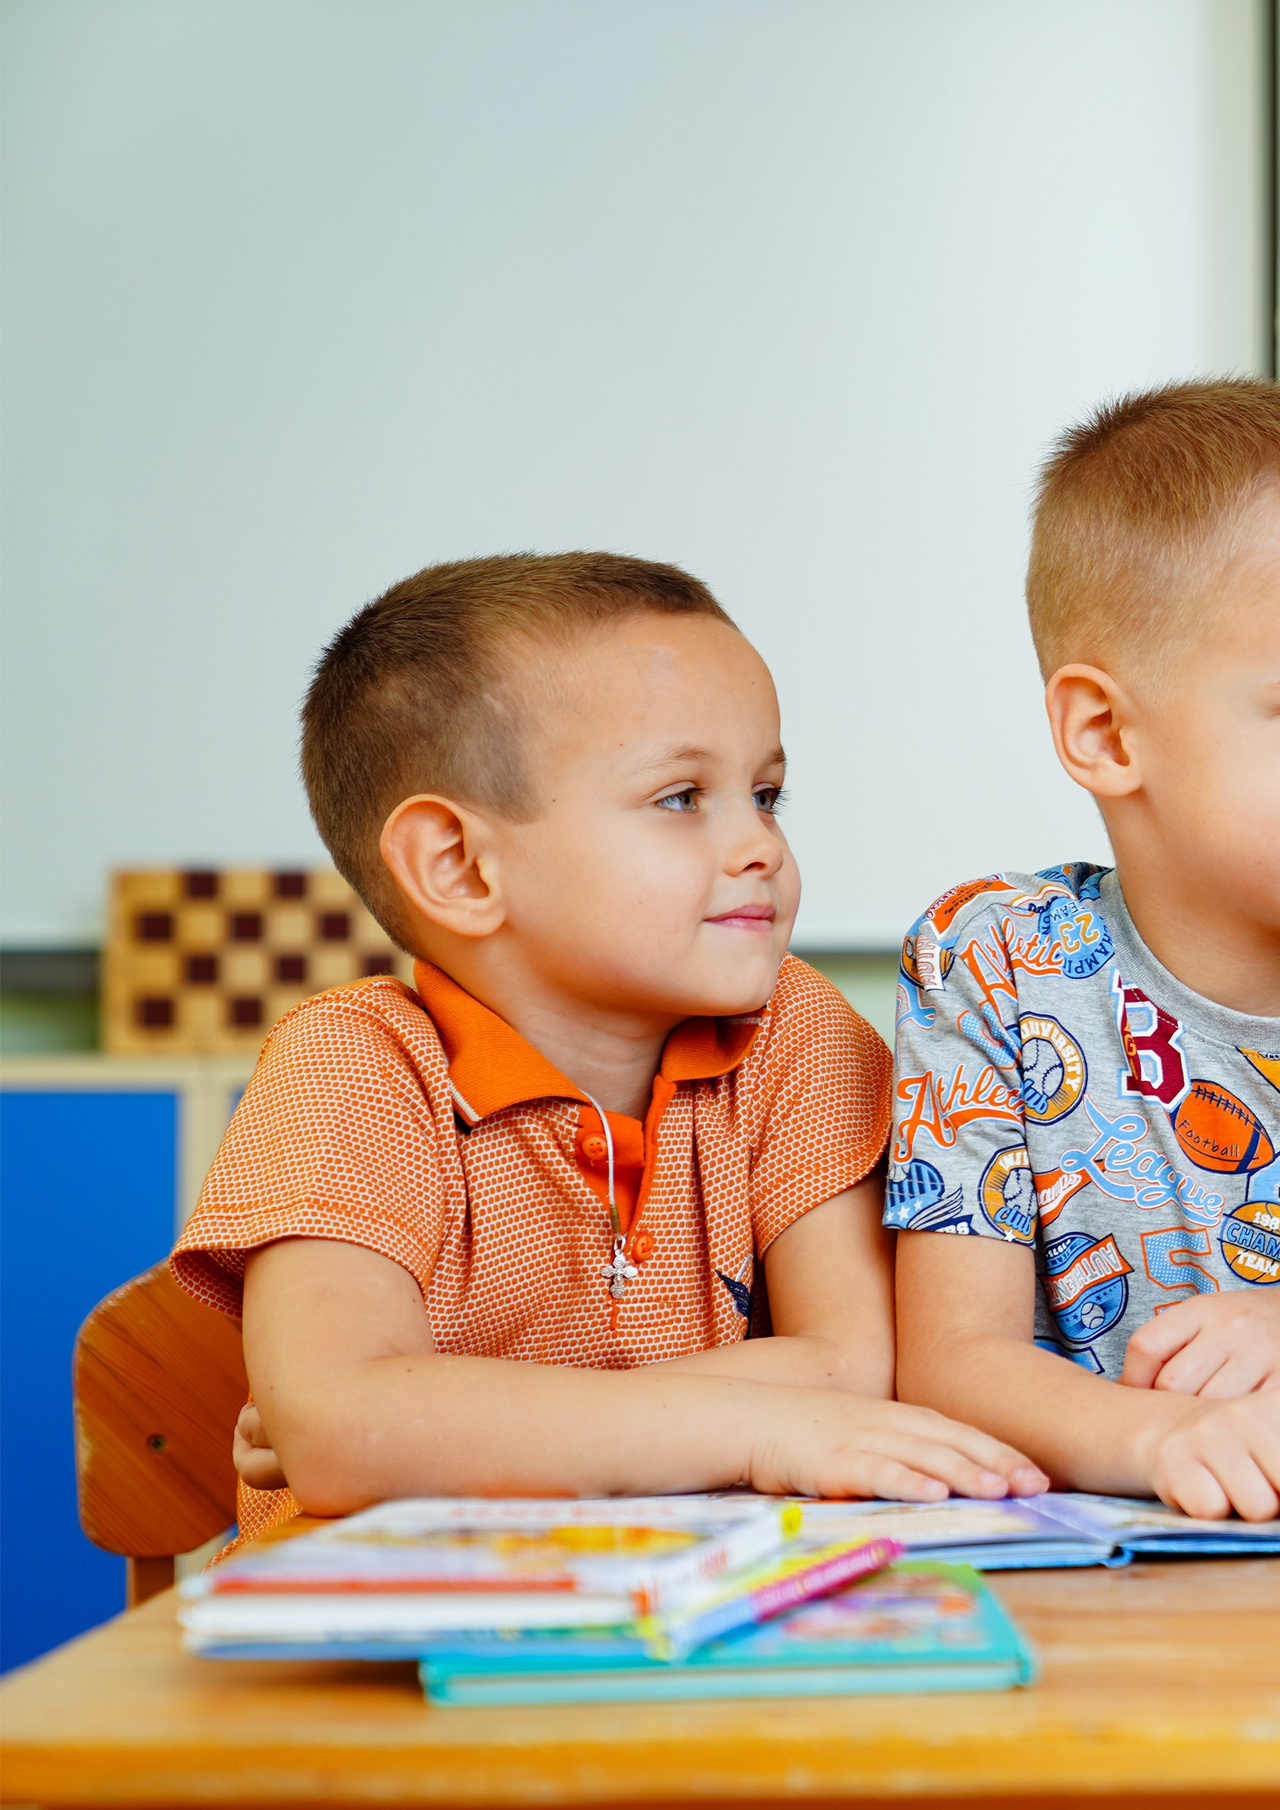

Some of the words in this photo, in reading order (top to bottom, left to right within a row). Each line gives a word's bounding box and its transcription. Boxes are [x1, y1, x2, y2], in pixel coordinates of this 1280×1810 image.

[1057, 912, 1099, 955] 23
[1111, 967, 1192, 1112] B
[1023, 1078, 1049, 1114] lub
[1178, 1118, 1240, 1158] Football
[1060, 1092, 1226, 1228] League
[994, 1205, 1032, 1236] club
[1237, 1250, 1280, 1278] TEAM
